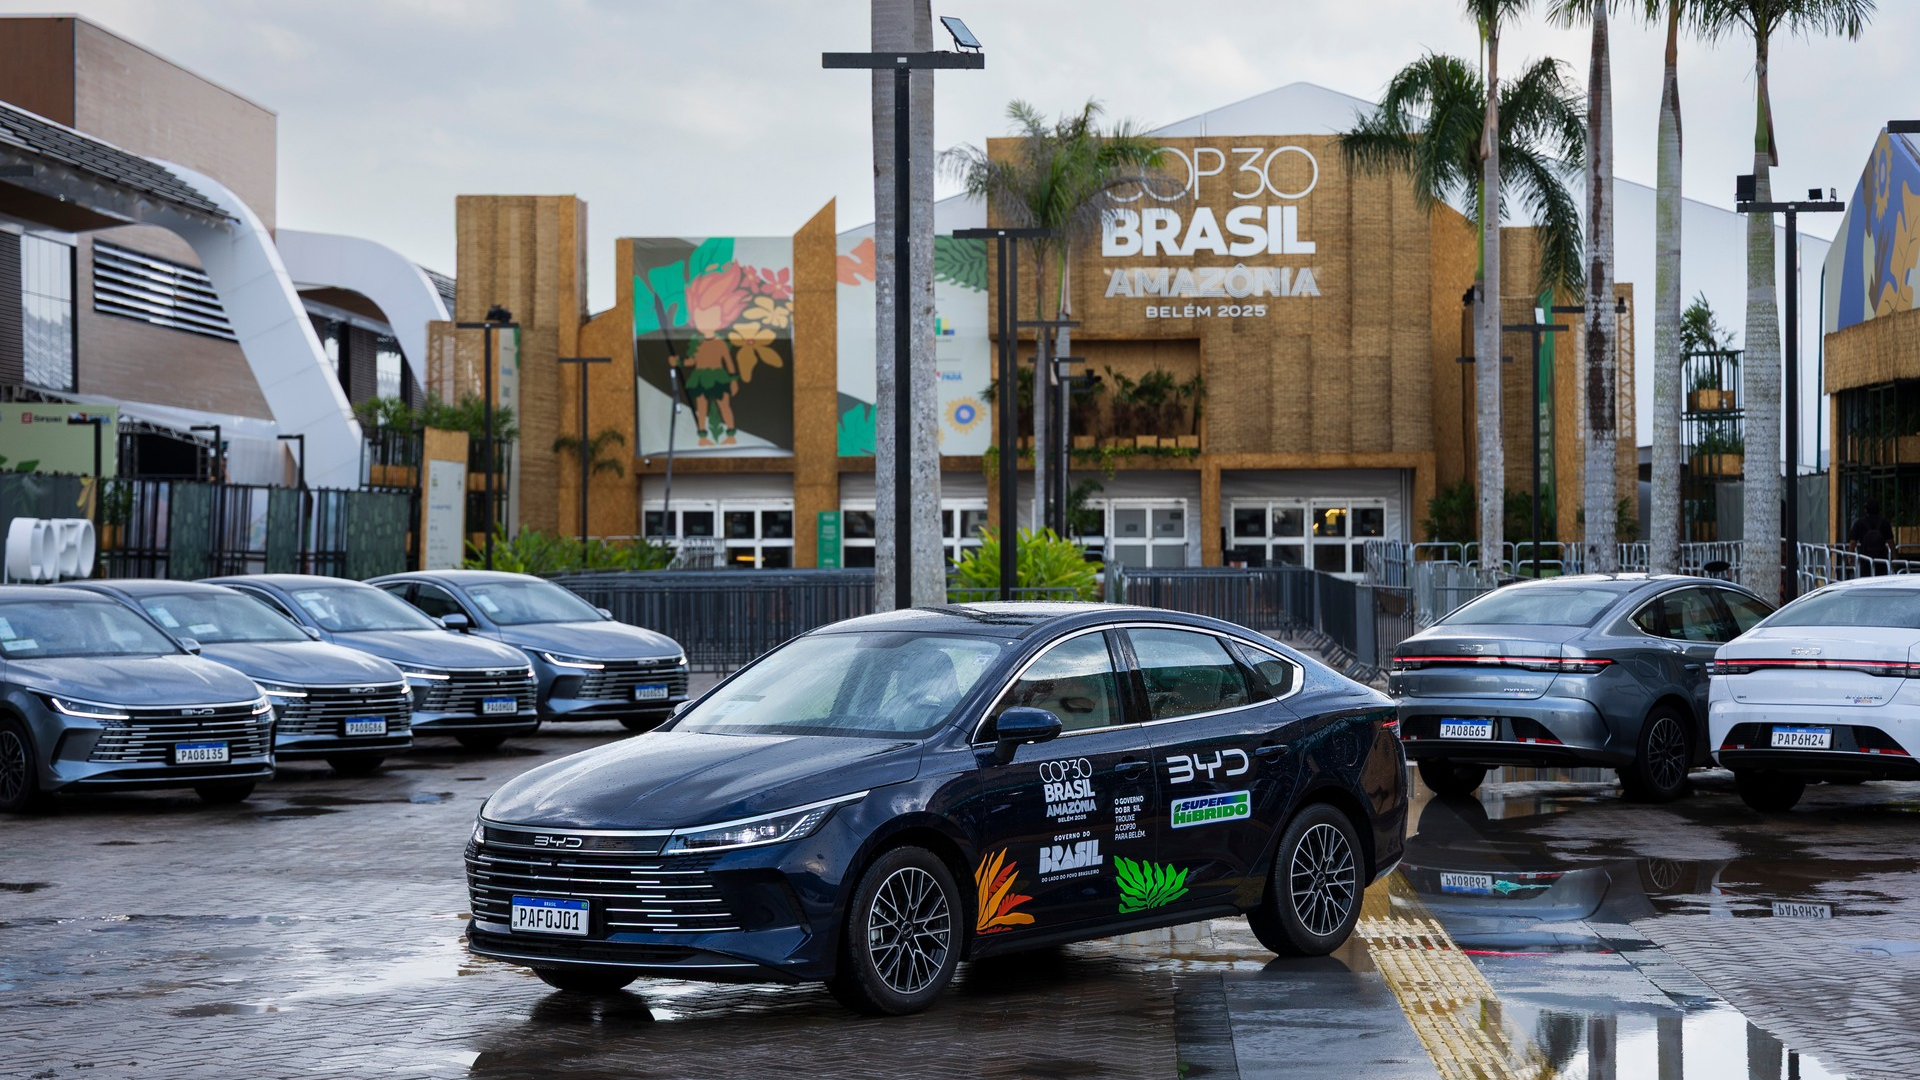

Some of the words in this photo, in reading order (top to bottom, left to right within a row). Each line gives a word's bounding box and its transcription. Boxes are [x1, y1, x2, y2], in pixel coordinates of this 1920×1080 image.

[1101, 205, 1316, 257] BRASIL
[1104, 263, 1321, 298] AMAZÔNIA
[1146, 304, 1211, 318] BELÉM
[1218, 305, 1266, 318] 2025
[1777, 733, 1824, 746] PAP6H24
[1166, 748, 1249, 784] BYD
[1043, 779, 1096, 803] BRASIL
[1119, 795, 1144, 804] GOVERNO
[1181, 797, 1224, 811] SUPER
[1046, 799, 1097, 818] AMAZÔNIA
[1057, 815, 1074, 823] BELÉM
[1115, 813, 1136, 822] TROUXE
[1119, 822, 1136, 831] COP30
[534, 835, 583, 848] BYD
[1053, 832, 1080, 841] GOVERNO
[1082, 830, 1091, 838] DO
[1114, 832, 1128, 840] PARA
[1039, 839, 1103, 875] BRASIL
[1078, 869, 1100, 877] BRASILEIRO
